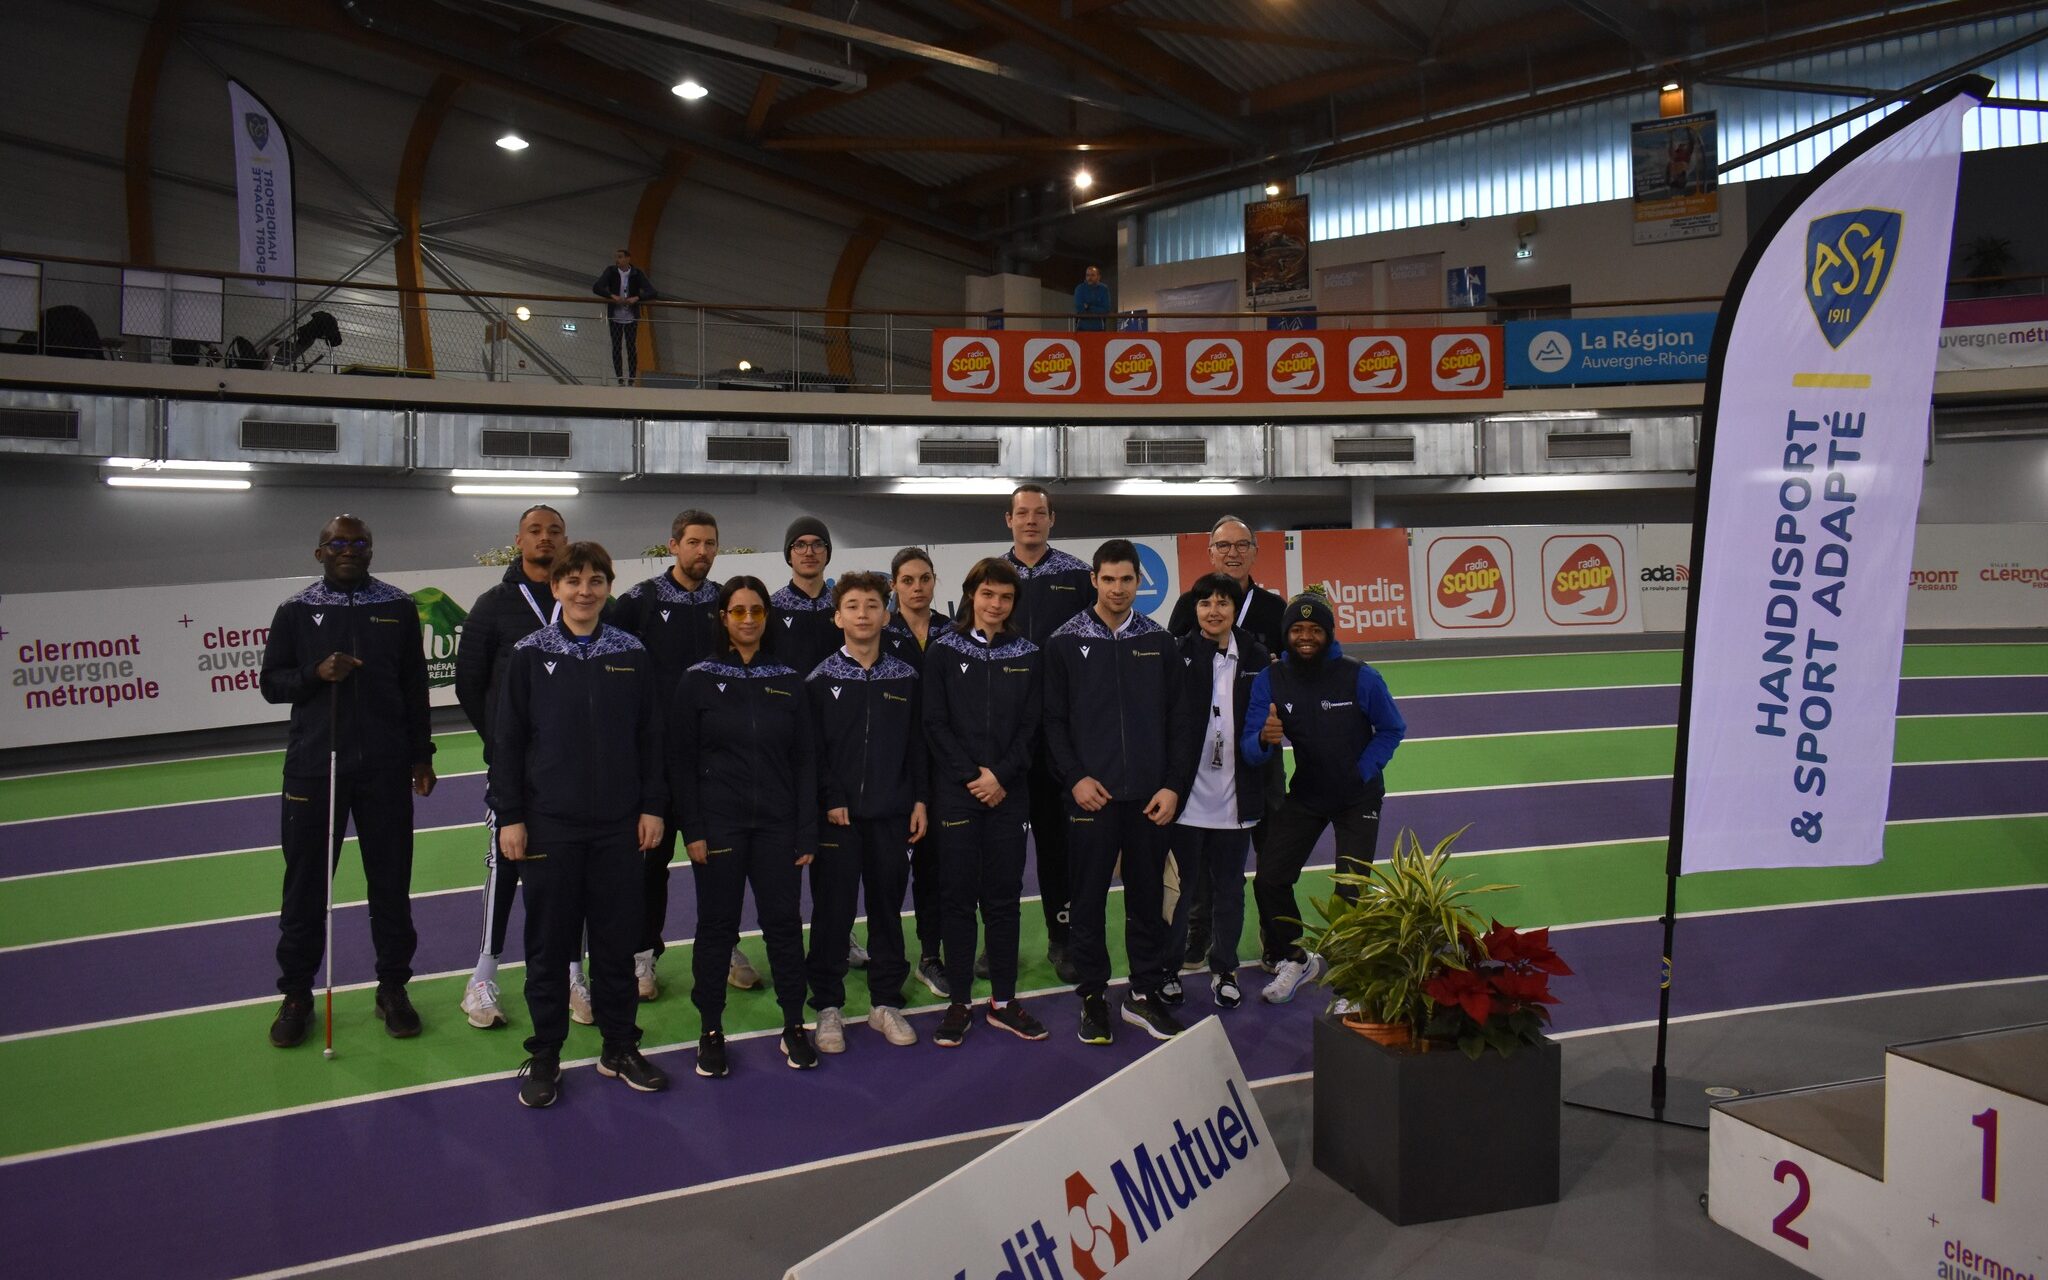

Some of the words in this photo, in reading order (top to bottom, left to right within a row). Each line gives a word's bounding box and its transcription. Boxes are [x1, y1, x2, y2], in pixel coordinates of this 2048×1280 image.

[1828, 308, 1850, 323] 1911
[1582, 332, 1607, 350] La
[1613, 328, 1694, 351] Région
[968, 350, 984, 358] radio
[1049, 351, 1065, 359] radio
[1129, 352, 1146, 360] radio
[1210, 351, 1226, 359] radio
[1291, 351, 1309, 359] radio
[1373, 349, 1391, 358] radio
[1456, 347, 1474, 355] radio
[952, 357, 992, 372] SCOOP
[1033, 358, 1073, 374] SCOOP
[1114, 358, 1154, 375] SCOOP
[1195, 358, 1235, 374] SCOOP
[1276, 357, 1316, 373] SCOOP
[1358, 355, 1399, 372] SCOOP
[1441, 354, 1481, 370] SCOOP
[1582, 351, 1709, 370] Auvergne-Rhône
[1812, 411, 1866, 617] ADAPTÉ
[1465, 558, 1488, 571] radio
[1578, 556, 1600, 569] radio
[1443, 568, 1500, 594] SCOOP
[1557, 566, 1612, 592] SCOOP
[1641, 564, 1675, 581] ada
[1755, 410, 1820, 737] HANDISPORT
[1322, 578, 1405, 603] Nordic
[1338, 605, 1407, 633] Sport
[19, 634, 141, 663] clermont
[13, 660, 134, 687] auvergne
[211, 669, 260, 693] mét
[26, 677, 160, 709] métropole
[1794, 628, 1839, 796] SPORT
[1791, 810, 1823, 843] &
[1110, 1078, 1259, 1243] Mutuel
[1972, 1107, 1998, 1203] 1
[1773, 1160, 1811, 1250] 2
